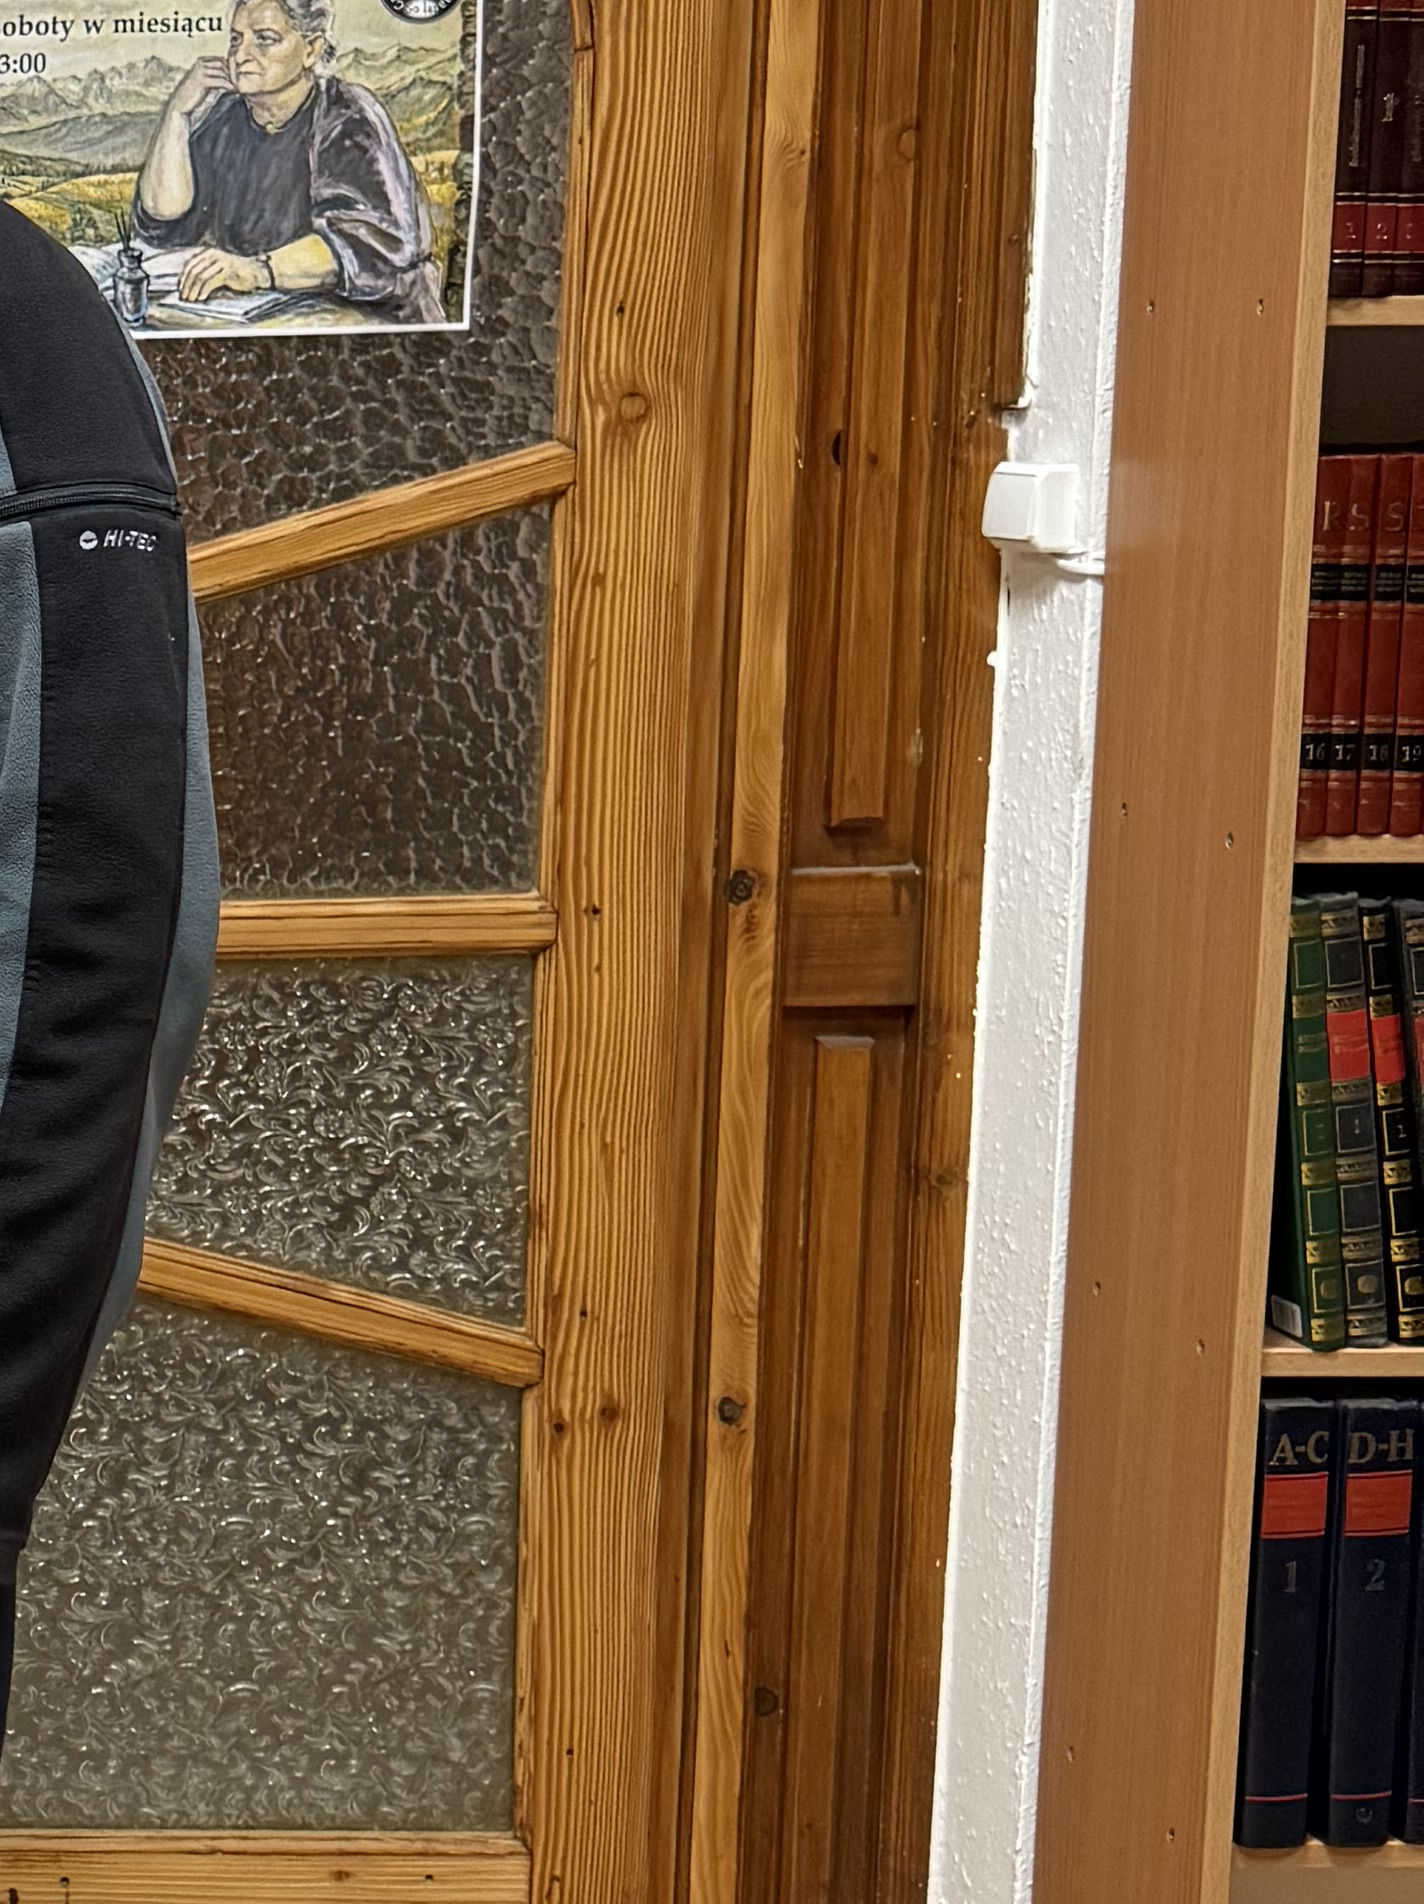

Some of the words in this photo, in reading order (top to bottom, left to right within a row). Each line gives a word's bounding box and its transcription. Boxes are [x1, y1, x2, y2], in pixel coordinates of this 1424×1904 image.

[83, 18, 106, 34] w
[113, 11, 224, 38] miesiącu
[1305, 742, 1326, 761] 16
[1335, 743, 1356, 762] 17
[1369, 744, 1390, 763] 18
[1401, 744, 1422, 764] 19
[1269, 1430, 1329, 1467] A-C
[1348, 1428, 1415, 1465] D-H
[1284, 1560, 1298, 1593] 1
[1364, 1558, 1386, 1592] 2
